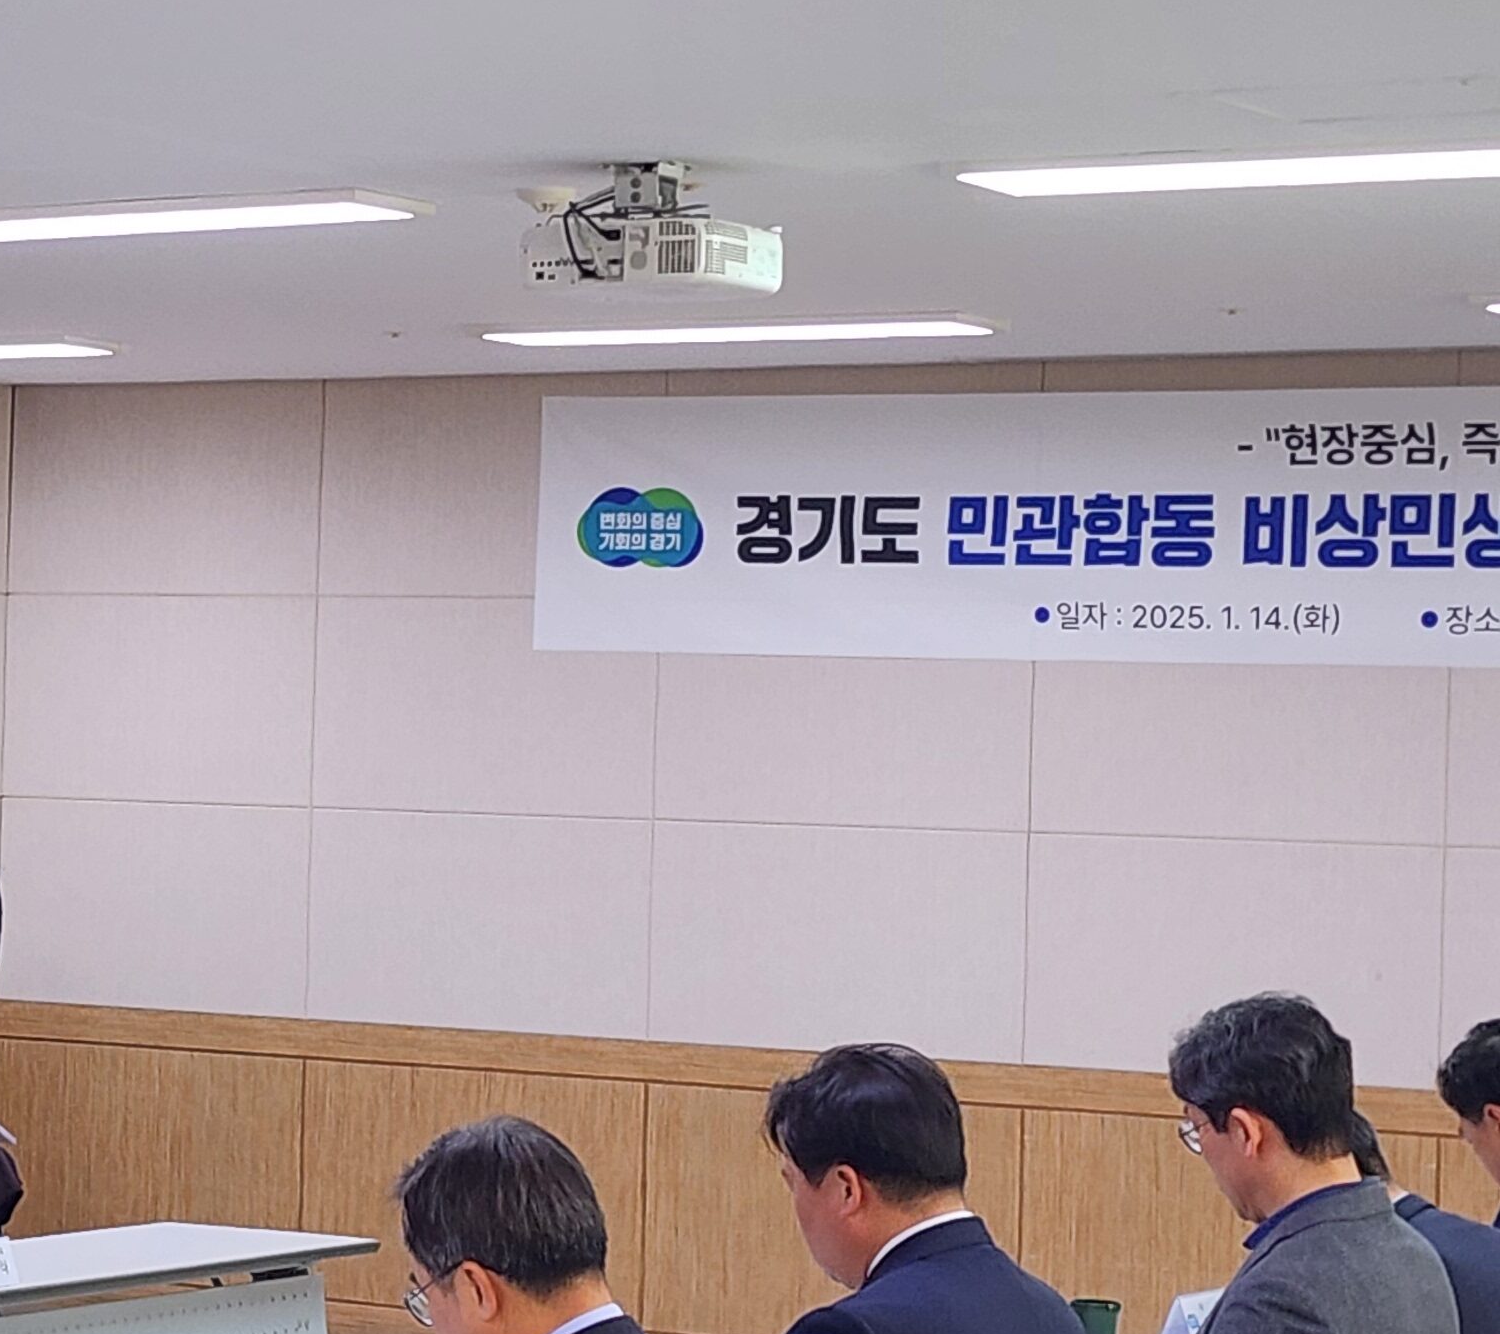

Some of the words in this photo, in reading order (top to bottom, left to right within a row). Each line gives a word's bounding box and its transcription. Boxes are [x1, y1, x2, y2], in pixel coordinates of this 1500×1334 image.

[1266, 422, 1449, 471] "현장중심,
[599, 533, 647, 551] 기회의
[650, 533, 681, 551] 경기
[734, 493, 921, 566] 경기도
[946, 491, 1215, 568] 민관합동
[1056, 601, 1107, 631] 일자
[1132, 605, 1212, 630] 2025.
[1445, 605, 1500, 635] 장소
